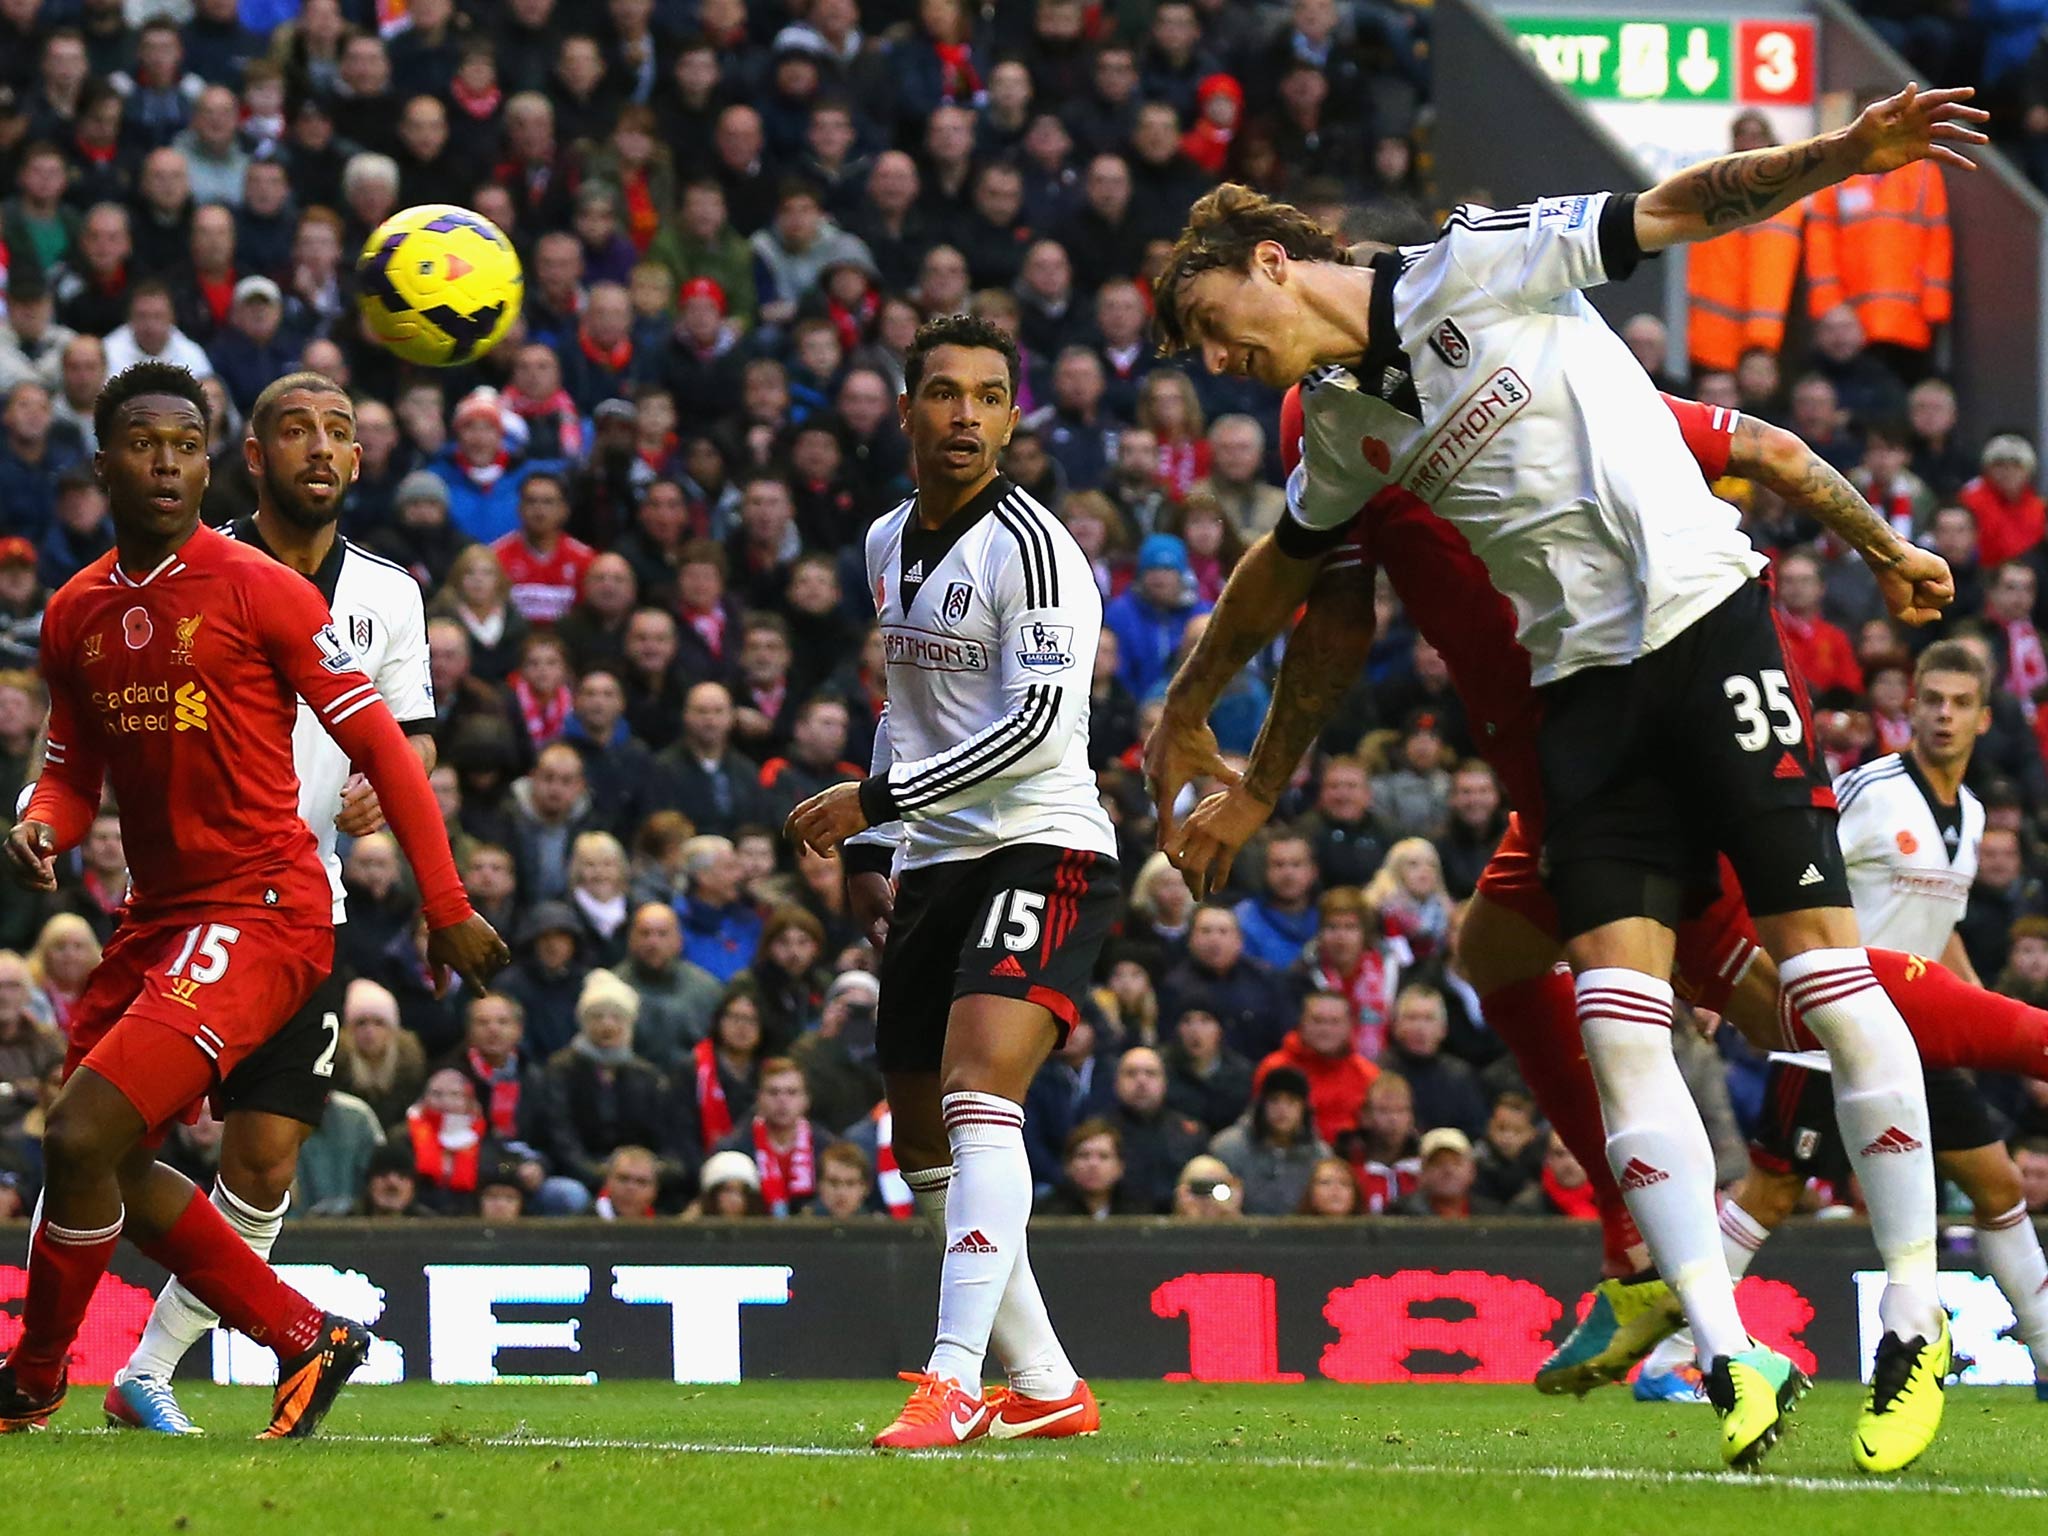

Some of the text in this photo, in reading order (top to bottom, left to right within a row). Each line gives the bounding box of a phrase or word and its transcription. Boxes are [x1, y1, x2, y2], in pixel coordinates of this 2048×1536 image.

[1754, 31, 1798, 94] 3
[1409, 390, 1507, 493] ARATHON
[884, 635, 963, 665] RATHON
[92, 680, 169, 712] Sadard
[1723, 669, 1803, 752] 35
[977, 888, 1046, 952] 15
[165, 923, 241, 984] 15
